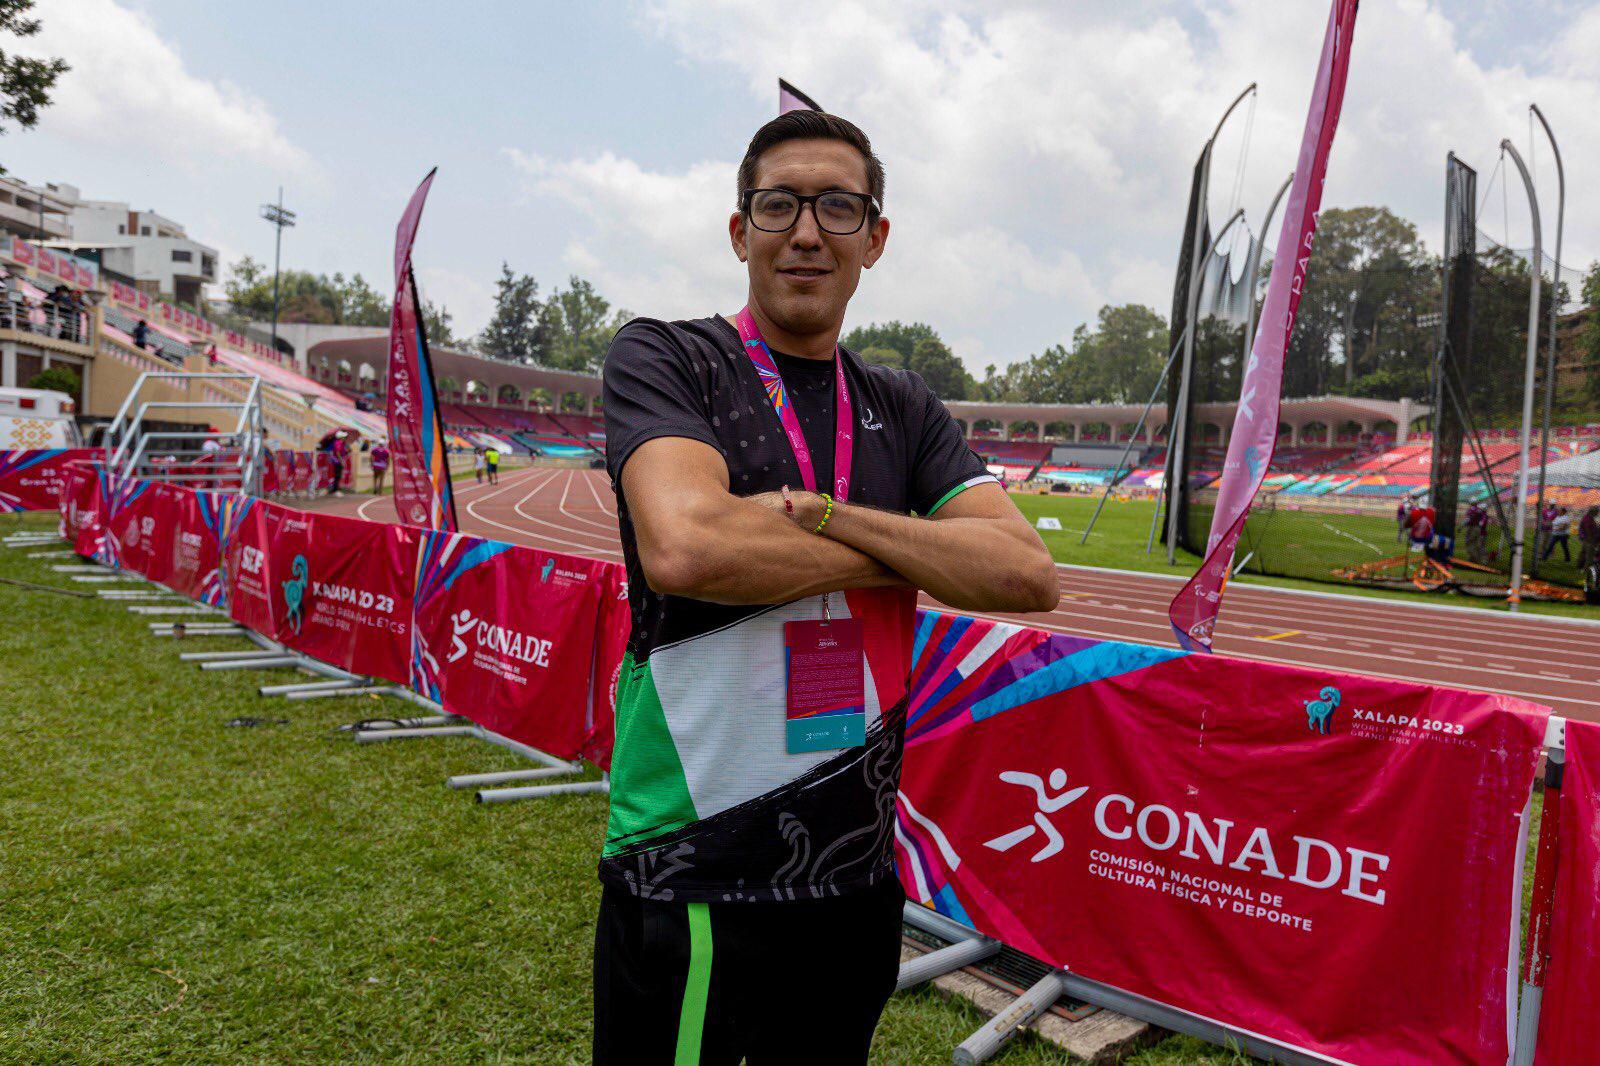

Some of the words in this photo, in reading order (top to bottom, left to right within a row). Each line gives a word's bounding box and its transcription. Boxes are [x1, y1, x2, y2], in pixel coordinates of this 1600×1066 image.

[476, 621, 553, 668] CONADE
[1353, 708, 1418, 729] XALAPA
[1422, 719, 1465, 736] 2023
[1089, 849, 1166, 877] COMISIÓN
[1170, 870, 1255, 901] NACIONAL
[1259, 892, 1284, 908] DE
[1094, 794, 1391, 906] CONADE
[1088, 863, 1157, 891] CULTURA
[1161, 882, 1212, 907] FÍSICA
[1217, 897, 1228, 909] Y
[1232, 901, 1313, 932] DEPORTE
